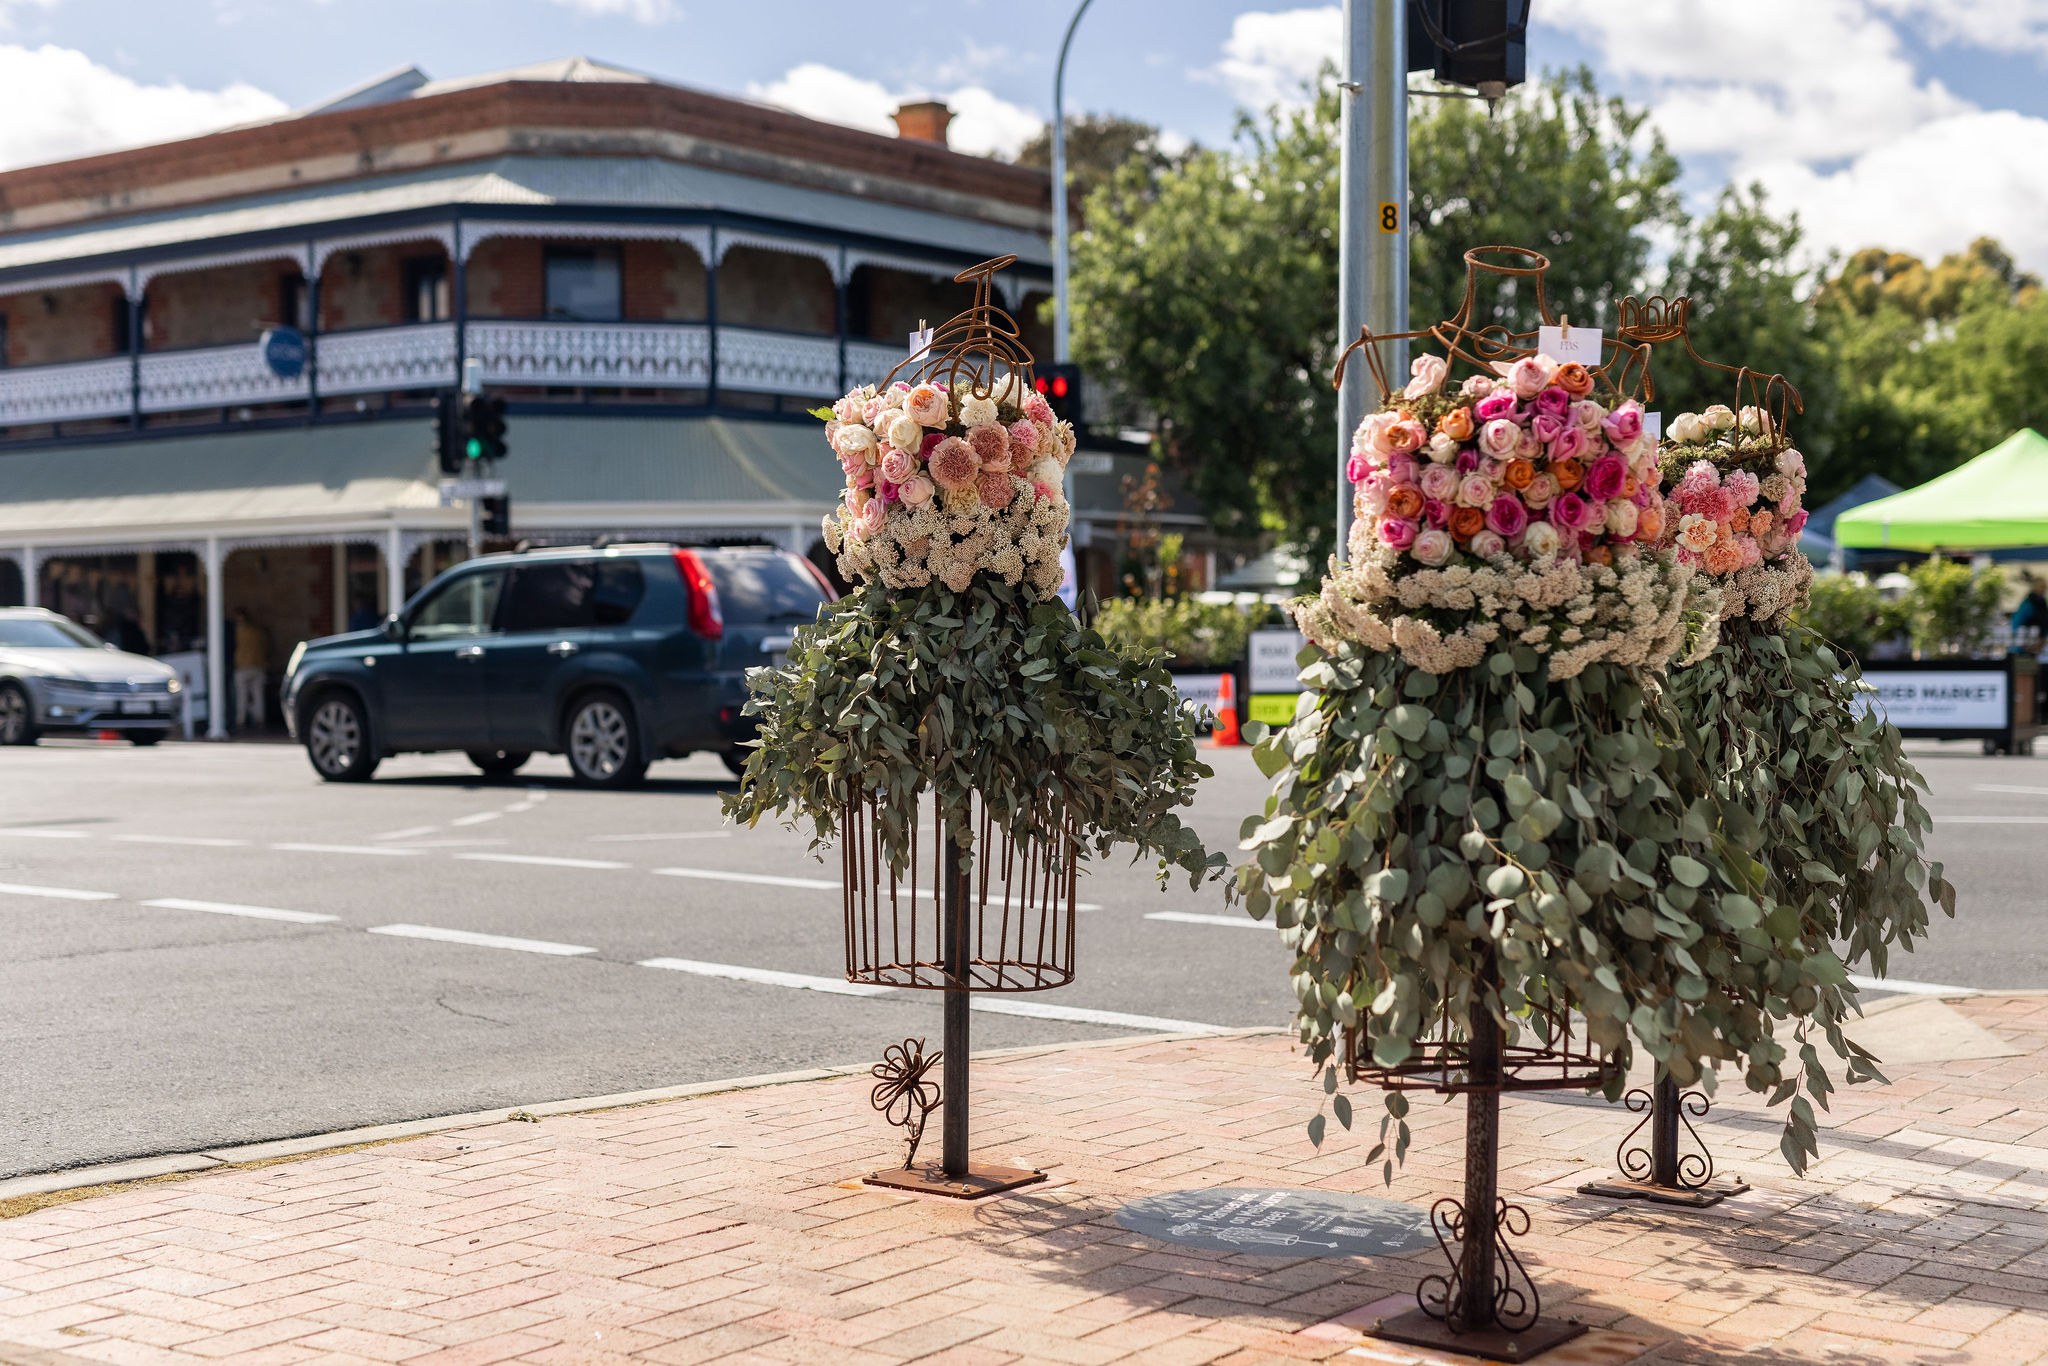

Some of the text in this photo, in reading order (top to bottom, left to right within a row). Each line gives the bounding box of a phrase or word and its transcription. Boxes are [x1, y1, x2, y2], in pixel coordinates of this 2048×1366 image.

[1382, 205, 1397, 230] 8
[1921, 684, 1998, 702] MARKET
[1250, 1211, 1290, 1227] Street
